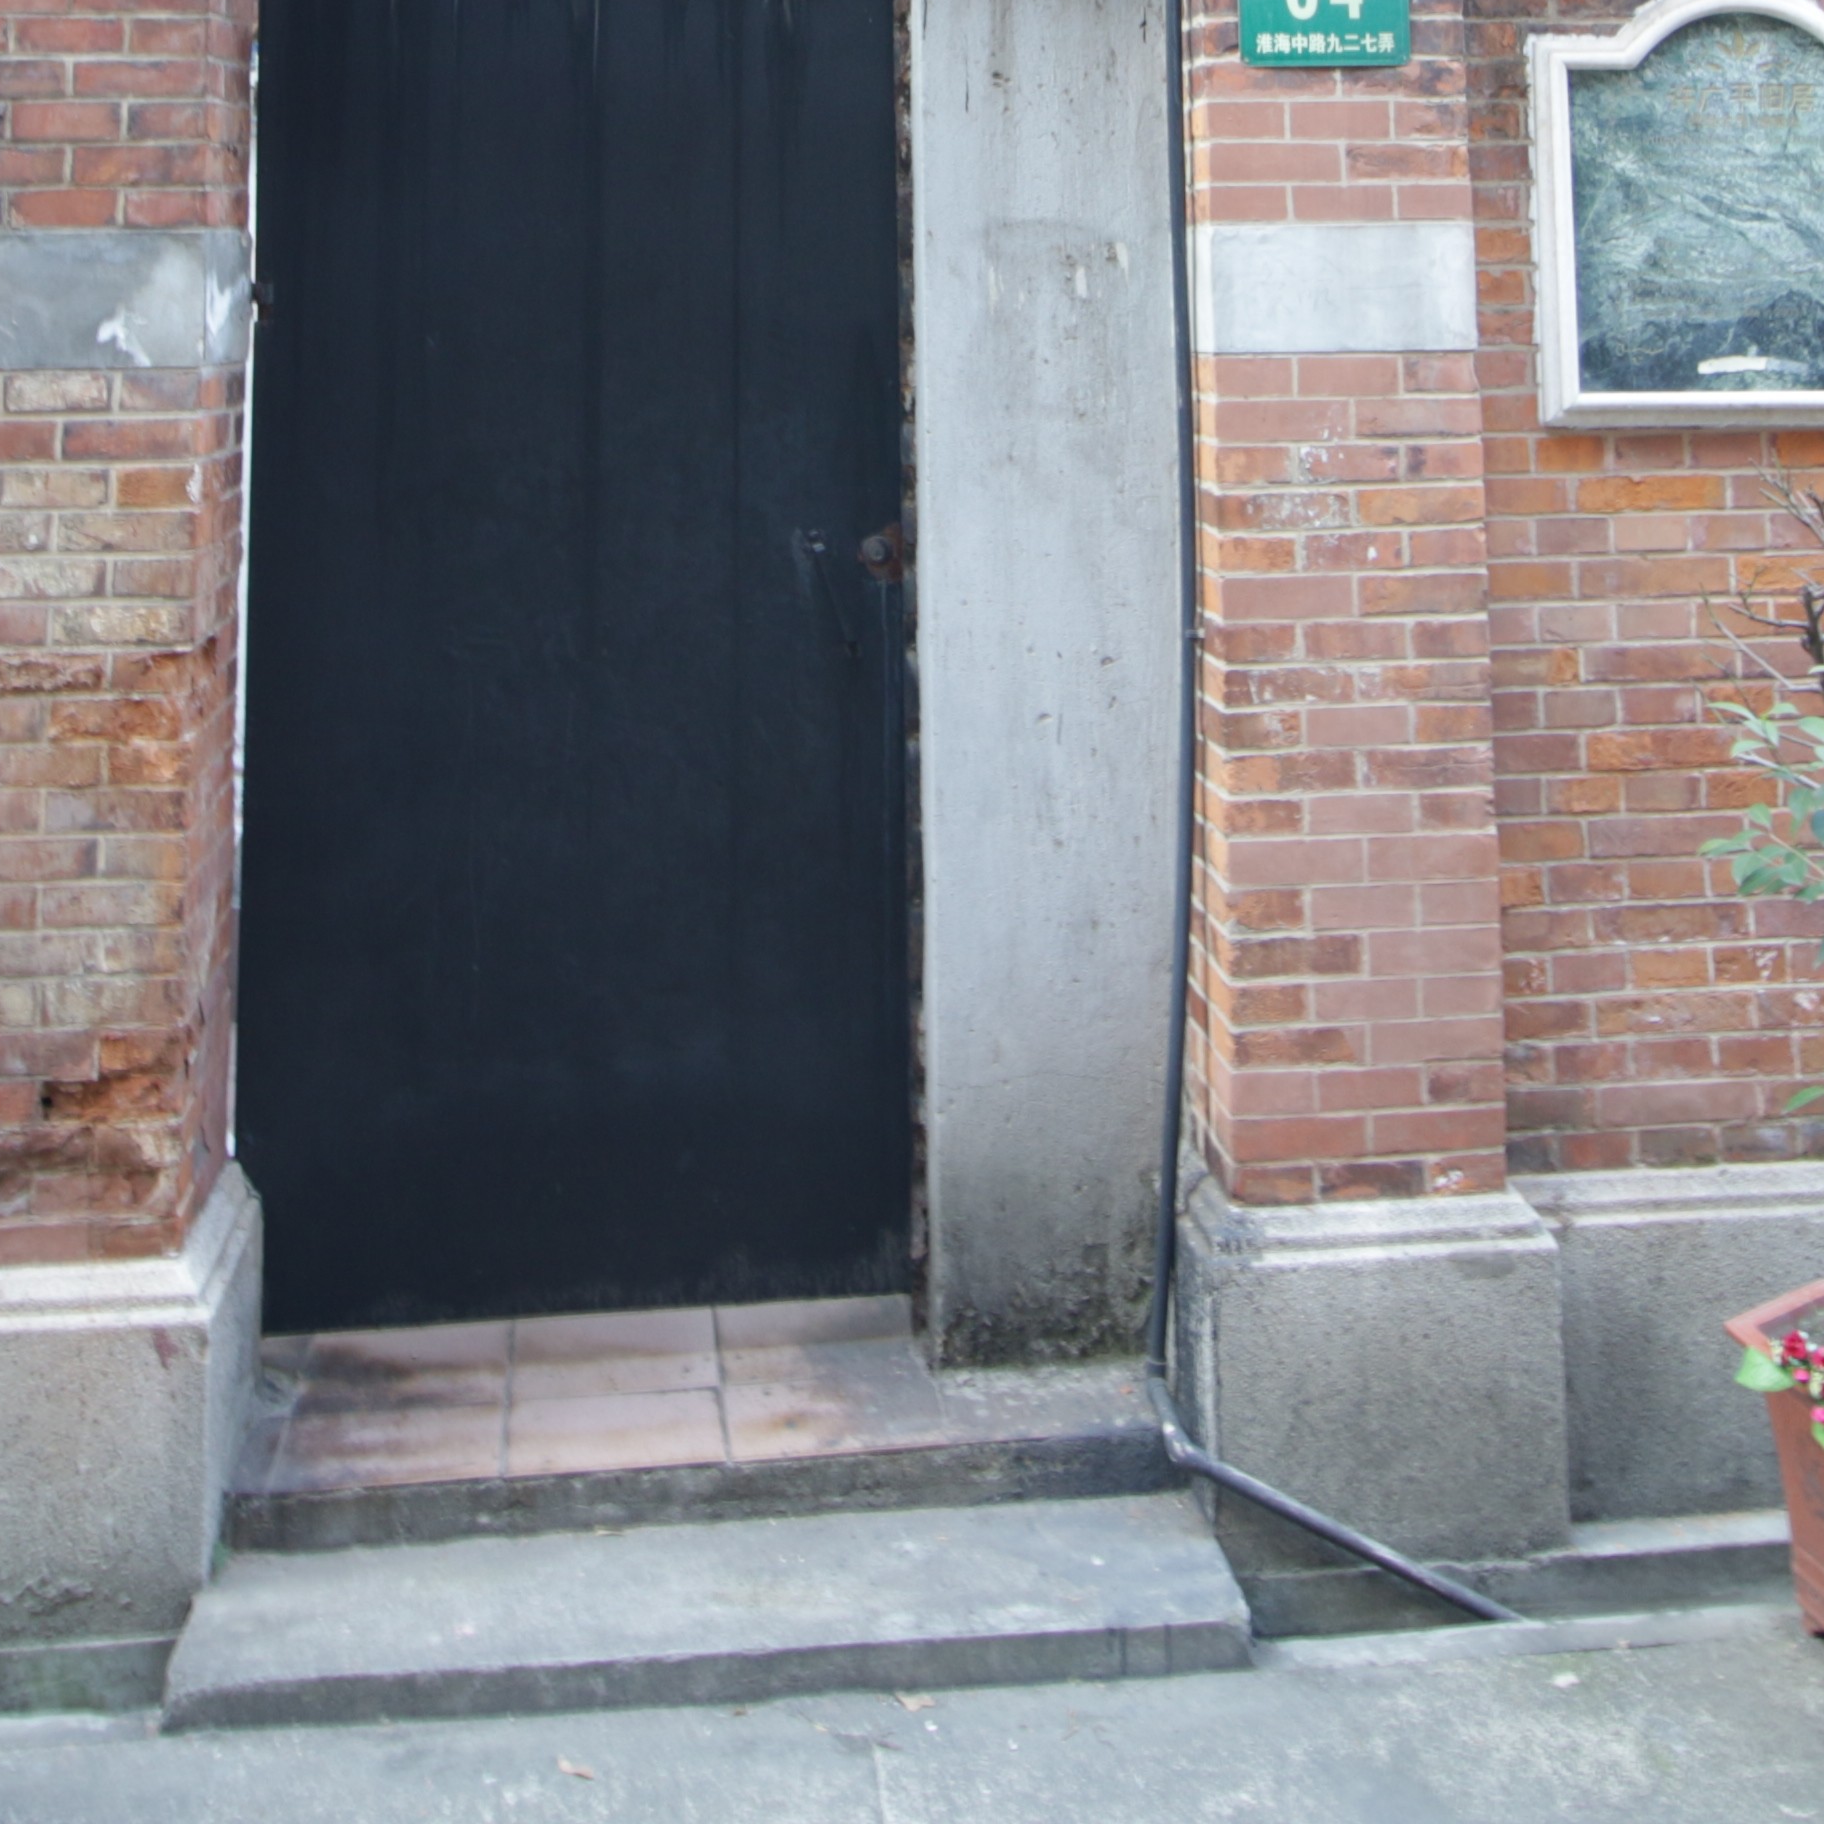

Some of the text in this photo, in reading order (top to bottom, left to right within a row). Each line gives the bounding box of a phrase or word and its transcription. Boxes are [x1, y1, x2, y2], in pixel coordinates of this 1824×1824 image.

[1256, 32, 1396, 54] 淮海中路九二七弄
